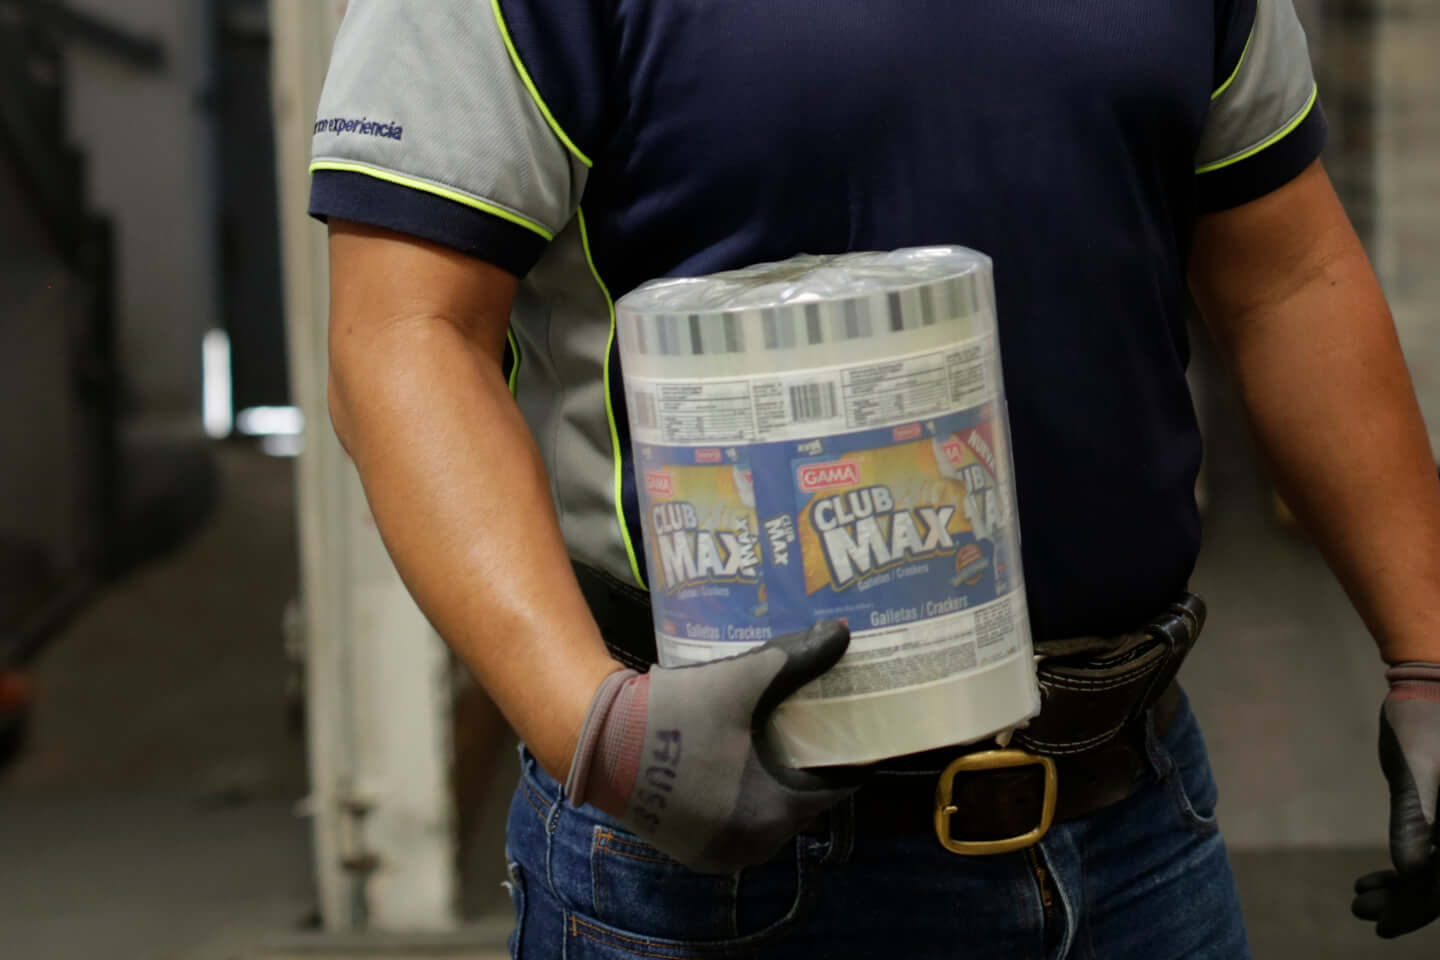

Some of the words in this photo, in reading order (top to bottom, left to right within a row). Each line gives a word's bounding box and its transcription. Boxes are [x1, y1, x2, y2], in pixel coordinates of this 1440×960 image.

[328, 117, 402, 141] experiencia
[804, 466, 857, 486] GAMA
[653, 503, 697, 535] CLUB
[814, 486, 893, 531] CLUB
[764, 519, 789, 565] MAX
[823, 506, 955, 584] MAX
[657, 531, 757, 589] MAX
[870, 607, 918, 627] Galletas
[926, 595, 968, 617] Crackers
[728, 624, 772, 640] Crackers
